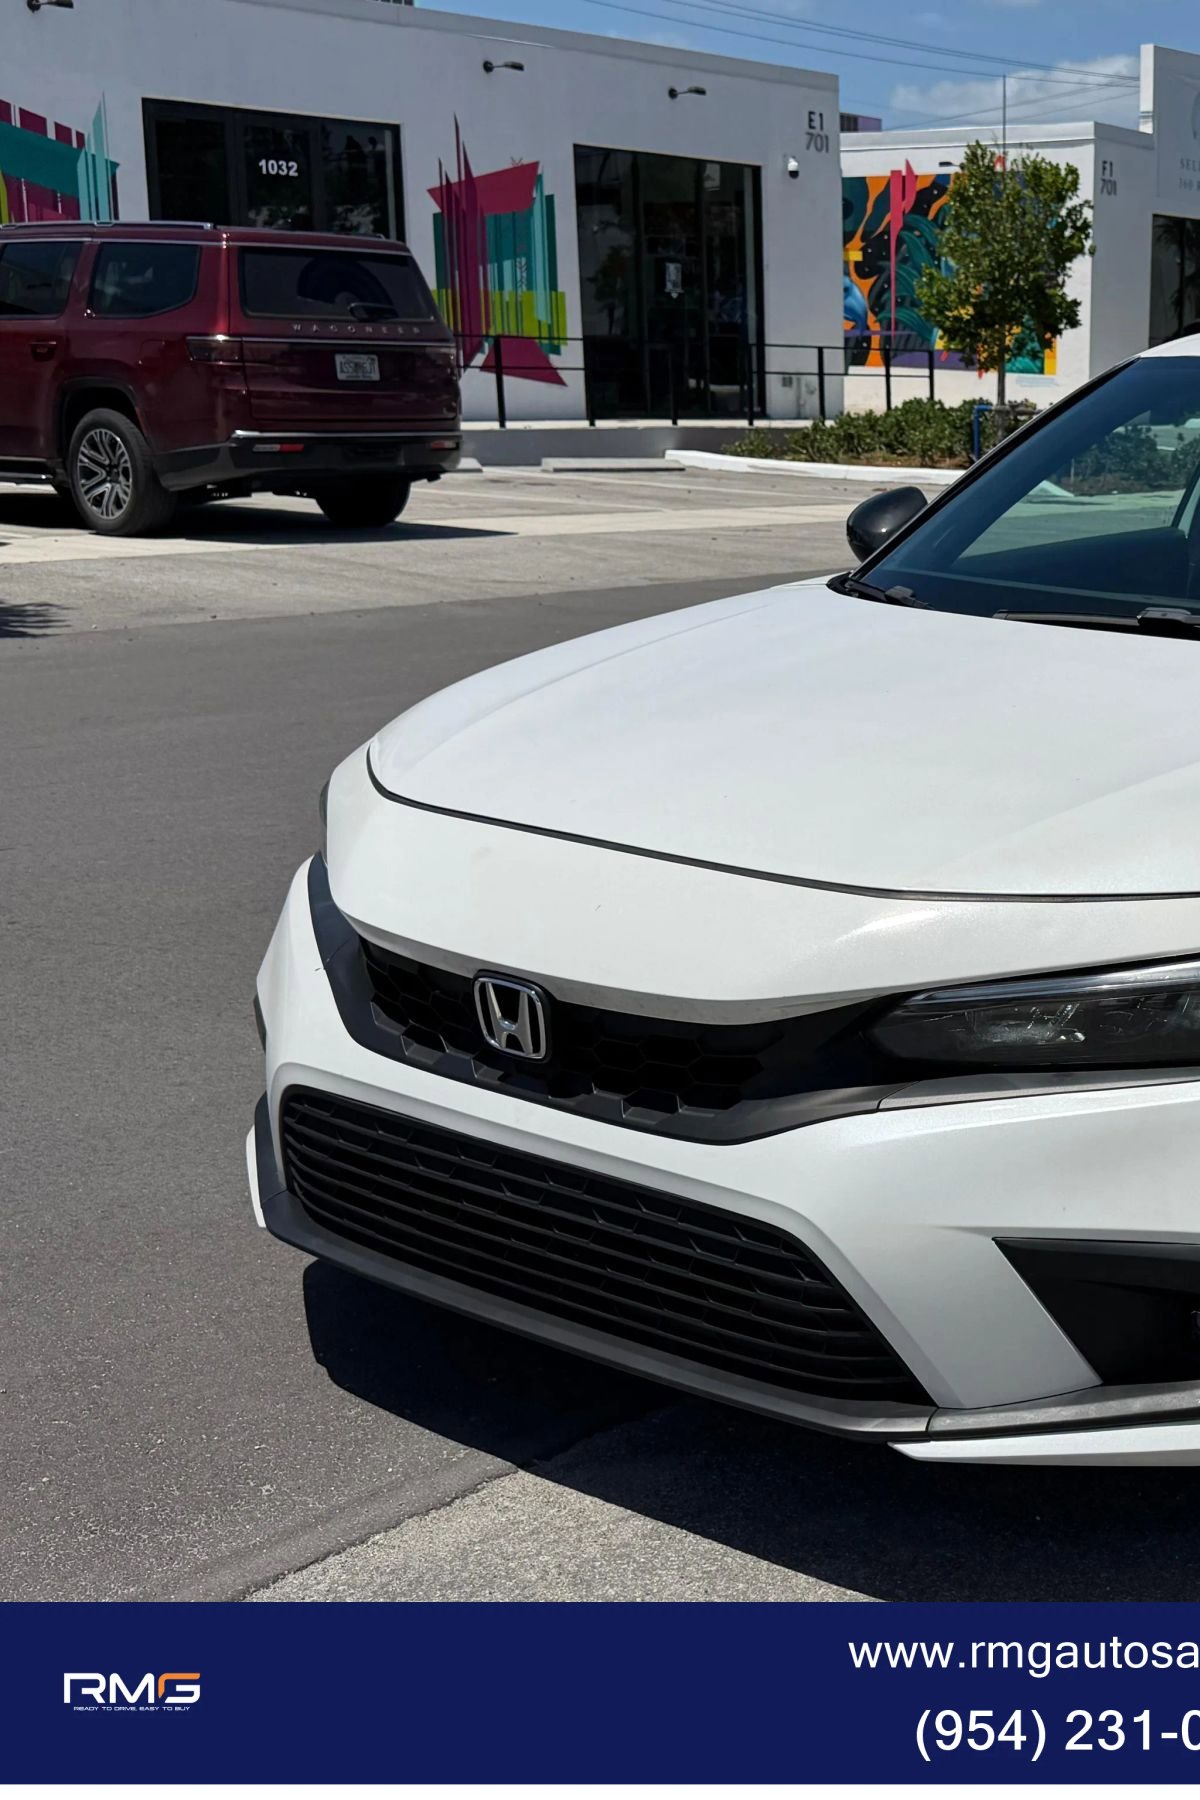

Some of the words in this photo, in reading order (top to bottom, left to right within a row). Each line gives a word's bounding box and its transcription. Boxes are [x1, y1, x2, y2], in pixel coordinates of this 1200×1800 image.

[808, 111, 824, 131] E1
[805, 132, 829, 153] 701
[258, 158, 299, 177] 1032
[1100, 178, 1117, 197] 701
